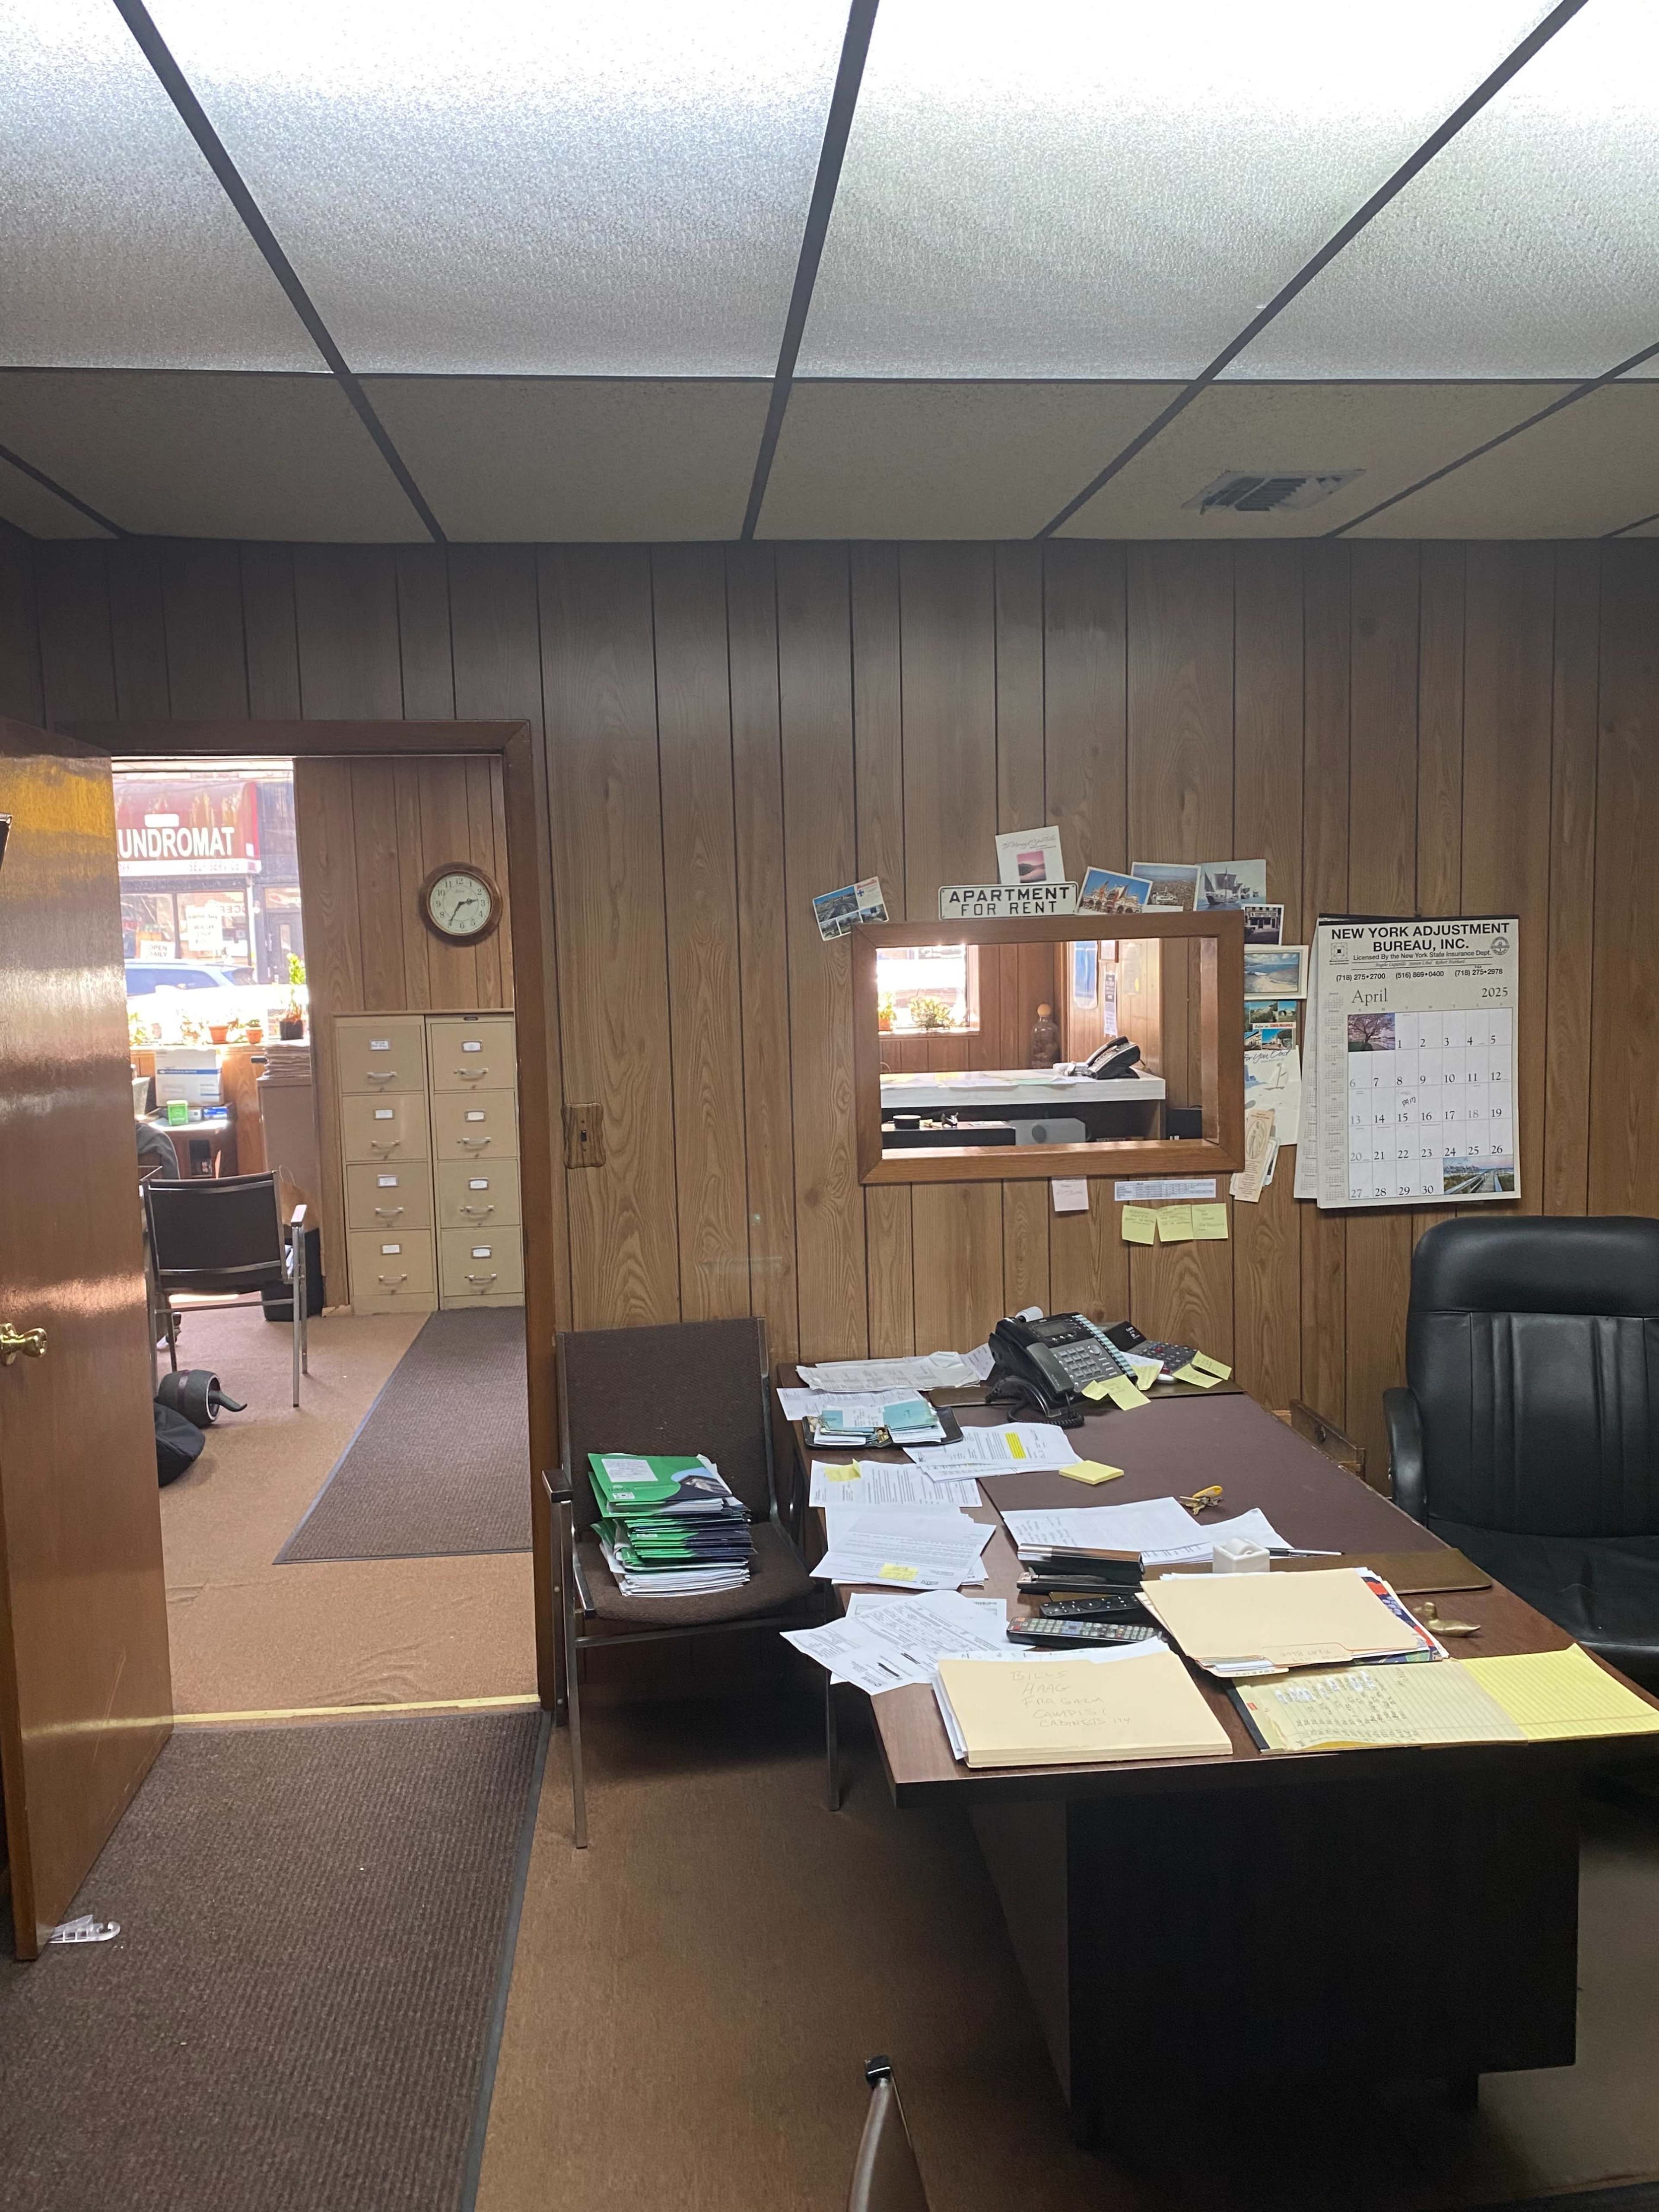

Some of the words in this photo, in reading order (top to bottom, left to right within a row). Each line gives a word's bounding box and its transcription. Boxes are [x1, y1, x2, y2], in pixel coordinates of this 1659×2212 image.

[118, 827, 235, 858] UNDROMAT
[949, 887, 1069, 903] APARTMENT
[961, 903, 996, 916] FOR
[1010, 901, 1057, 915] RENT
[1332, 928, 1364, 939] NEW
[1368, 926, 1409, 938] YORK
[1413, 923, 1510, 937] ADJUSTMENT
[1373, 940, 1436, 952] BUREAU,
[1441, 938, 1469, 950] INC.
[1351, 987, 1388, 1006] April
[1481, 987, 1508, 998] 2025
[1445, 1038, 1449, 1046] 3
[1467, 1037, 1472, 1045] 4
[1374, 1078, 1378, 1087] 7
[1492, 1072, 1501, 1080] 12
[1351, 1116, 1360, 1124] 13
[1376, 1115, 1384, 1123] 14
[1398, 1113, 1408, 1122] 15
[1446, 1111, 1455, 1119] 17
[1492, 1109, 1501, 1117] 19
[1351, 1153, 1362, 1161] 20
[1398, 1150, 1408, 1158] 22
[1422, 1149, 1432, 1157] 23
[1445, 1148, 1456, 1156] 24
[1468, 1146, 1478, 1155] 25
[1492, 1145, 1502, 1154] 26
[1351, 1189, 1362, 1198] 27
[1423, 1185, 1433, 1194] 30
